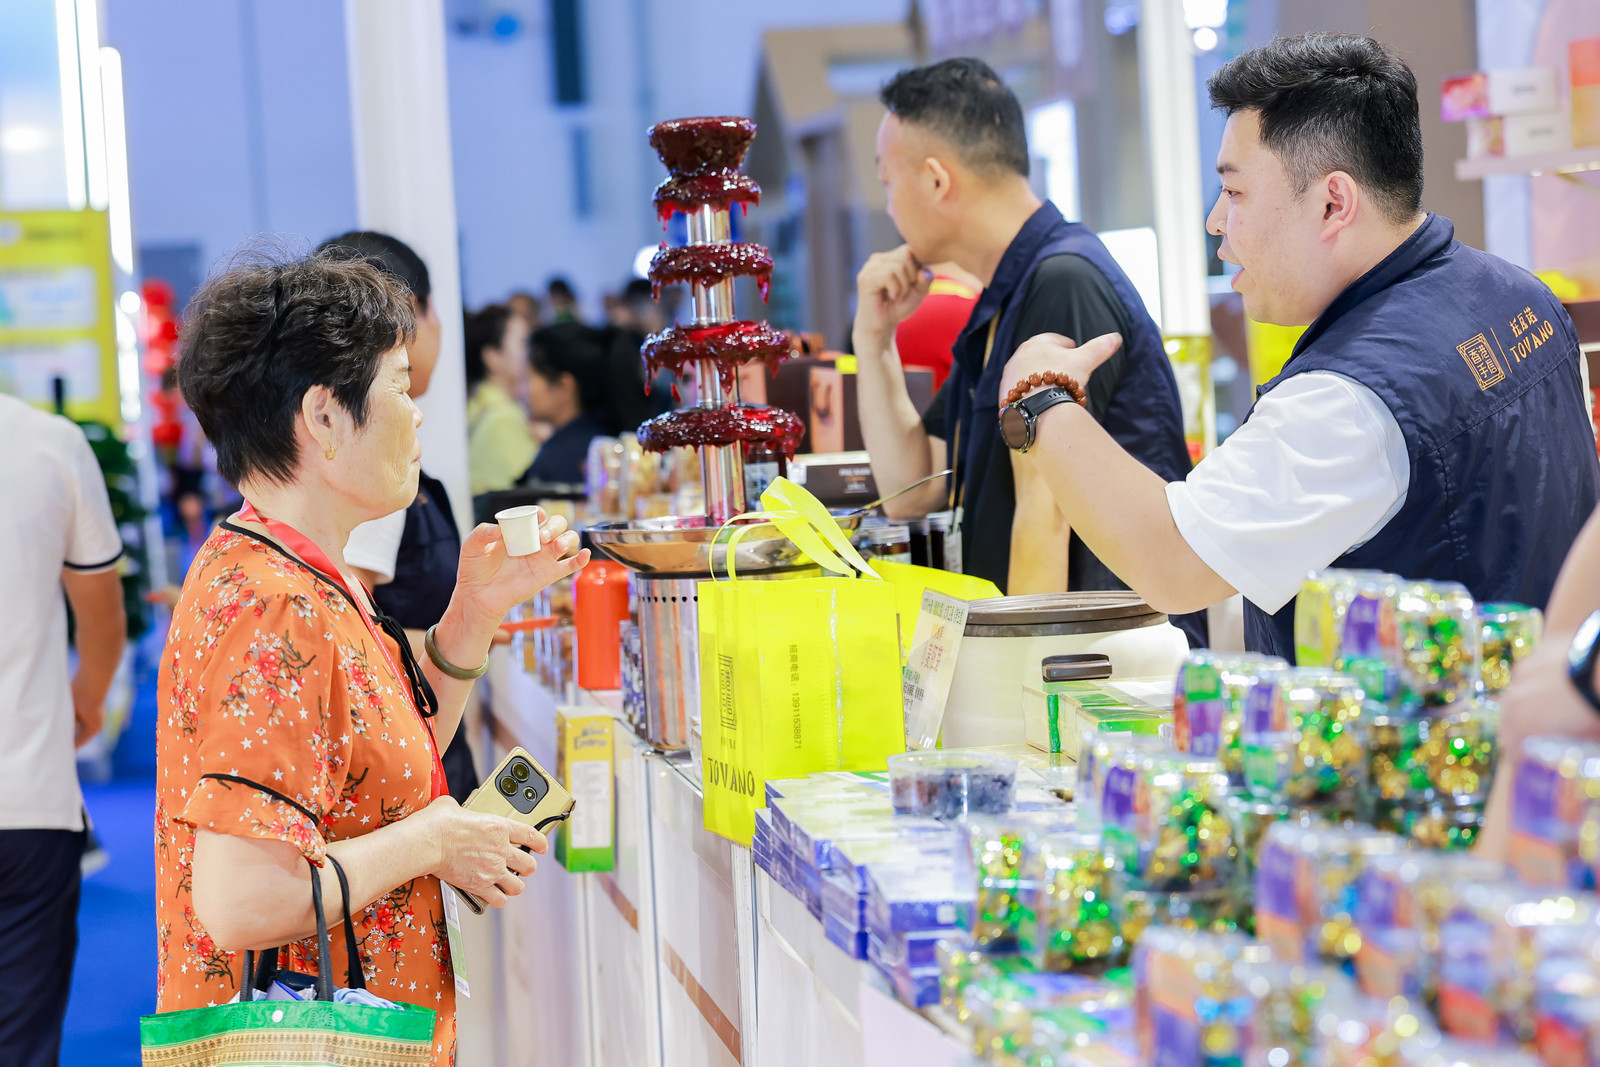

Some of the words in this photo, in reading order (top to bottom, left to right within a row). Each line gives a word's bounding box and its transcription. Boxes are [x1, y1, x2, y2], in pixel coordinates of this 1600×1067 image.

[1509, 306, 1538, 338] 托瓦诺
[1509, 320, 1554, 363] TOVANO
[708, 757, 755, 798] TOVANO
